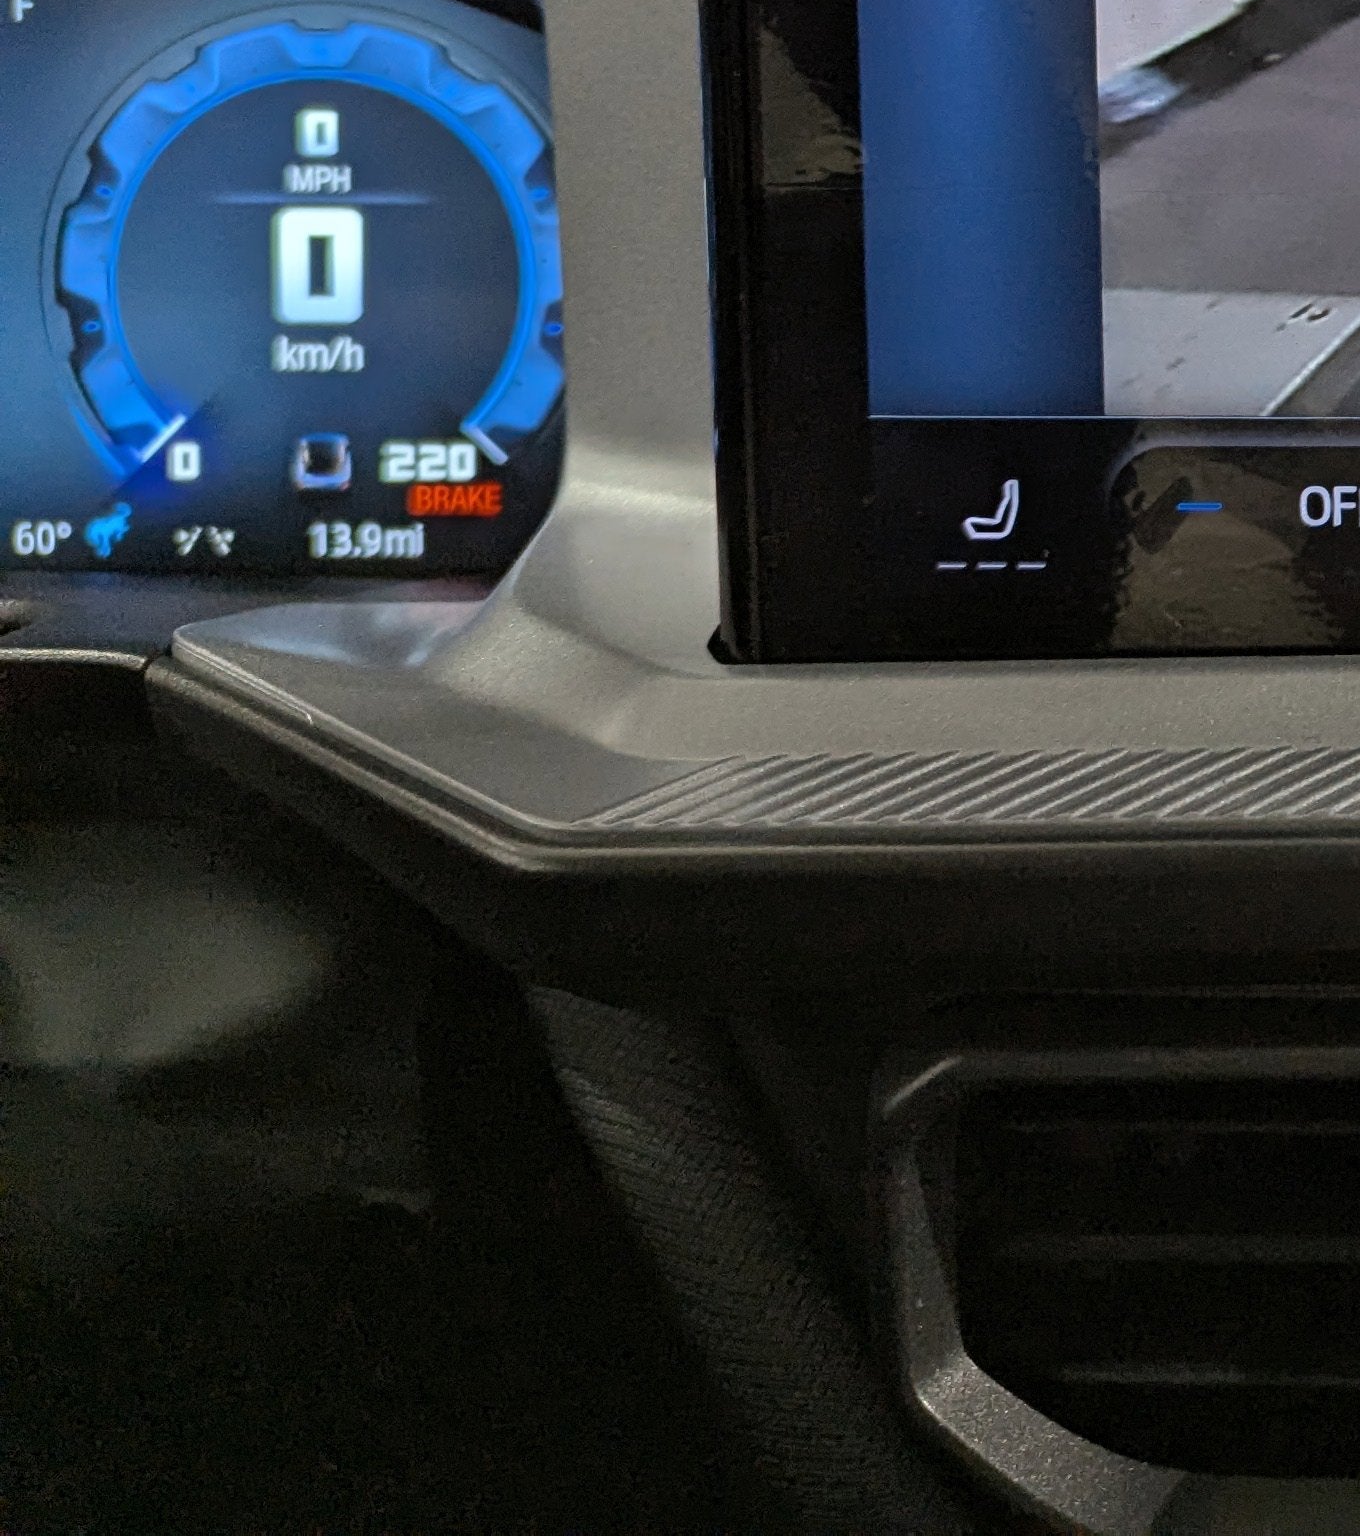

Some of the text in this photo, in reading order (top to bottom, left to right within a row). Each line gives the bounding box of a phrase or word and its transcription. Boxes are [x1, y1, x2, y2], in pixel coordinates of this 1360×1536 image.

[299, 109, 338, 155] 0
[287, 167, 351, 193] MPH
[274, 208, 363, 324] 0
[272, 336, 365, 372] km/h
[168, 442, 200, 481] 0
[383, 443, 477, 482] 220
[414, 485, 501, 512] BRAKE
